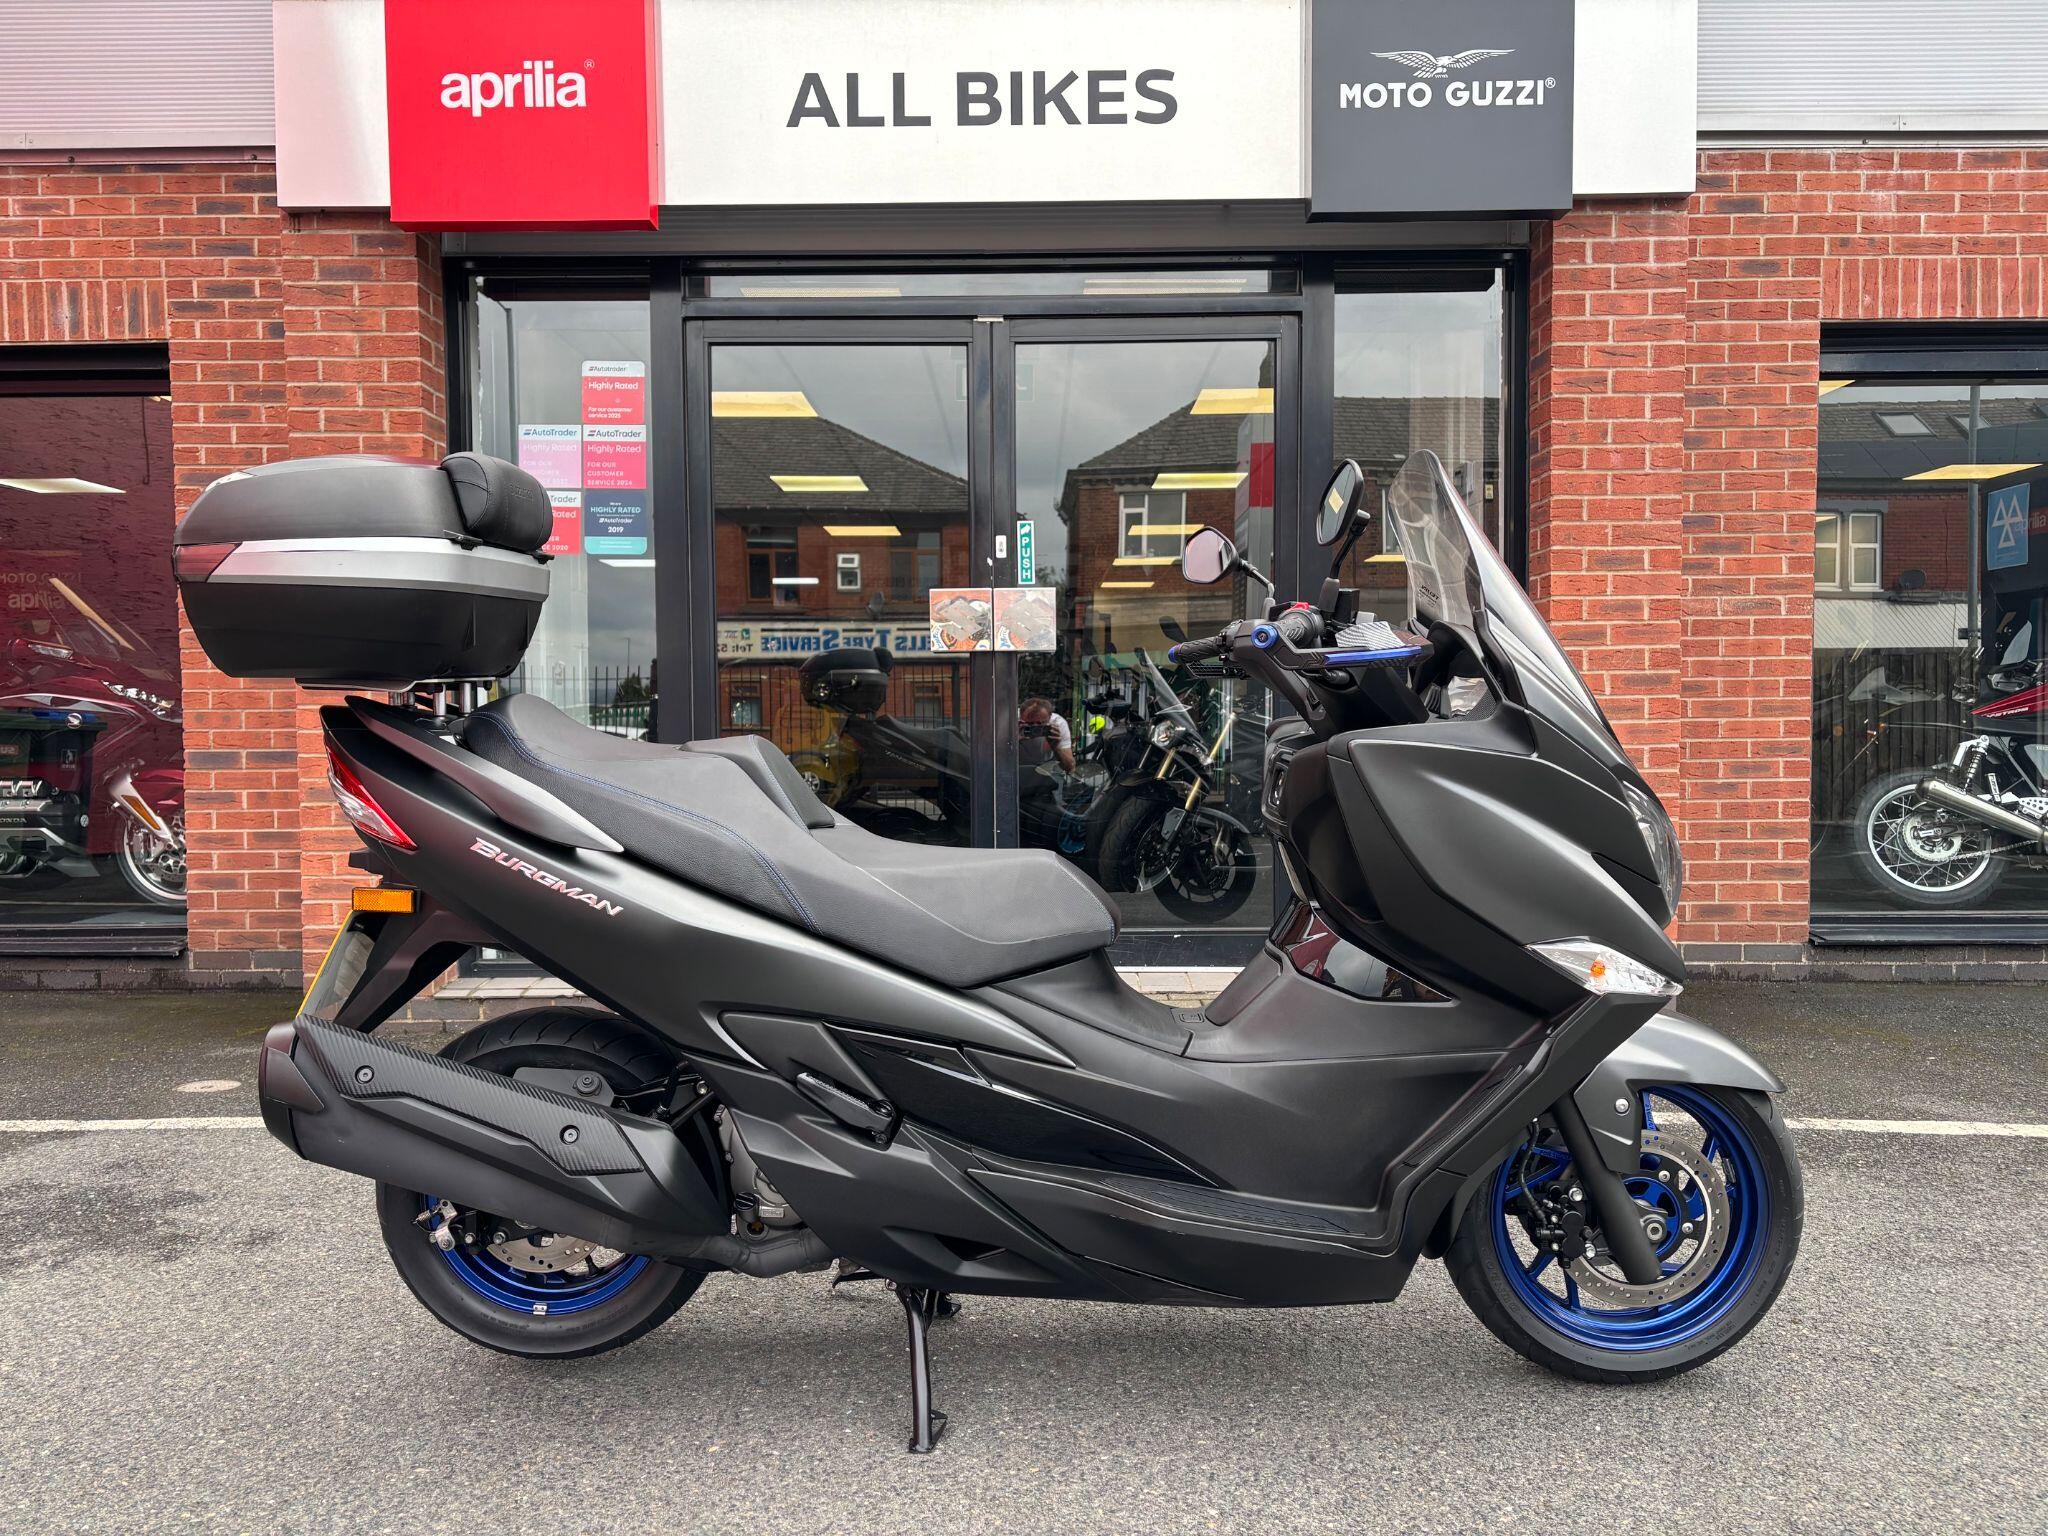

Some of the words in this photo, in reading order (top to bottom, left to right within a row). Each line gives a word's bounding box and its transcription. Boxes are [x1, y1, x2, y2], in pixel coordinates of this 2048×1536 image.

[440, 60, 587, 117] aprilia
[1340, 82, 1432, 108] MOTO
[1445, 79, 1544, 107] GUZZI
[786, 72, 931, 127] ALL
[956, 69, 1178, 126] BIKES
[588, 382, 614, 391] Highly
[614, 381, 639, 390] Rated
[531, 428, 578, 437] AutoTrader
[595, 429, 641, 438] AutoTrader
[523, 444, 550, 453] Highly
[551, 443, 577, 452] Rated
[587, 444, 614, 454] Highly
[615, 444, 641, 453] Rated
[550, 495, 577, 503] Trader
[551, 510, 577, 519] Rated
[617, 506, 641, 514] RATED
[1021, 537, 1031, 579] PUSH
[470, 837, 624, 917] BURGMAN
